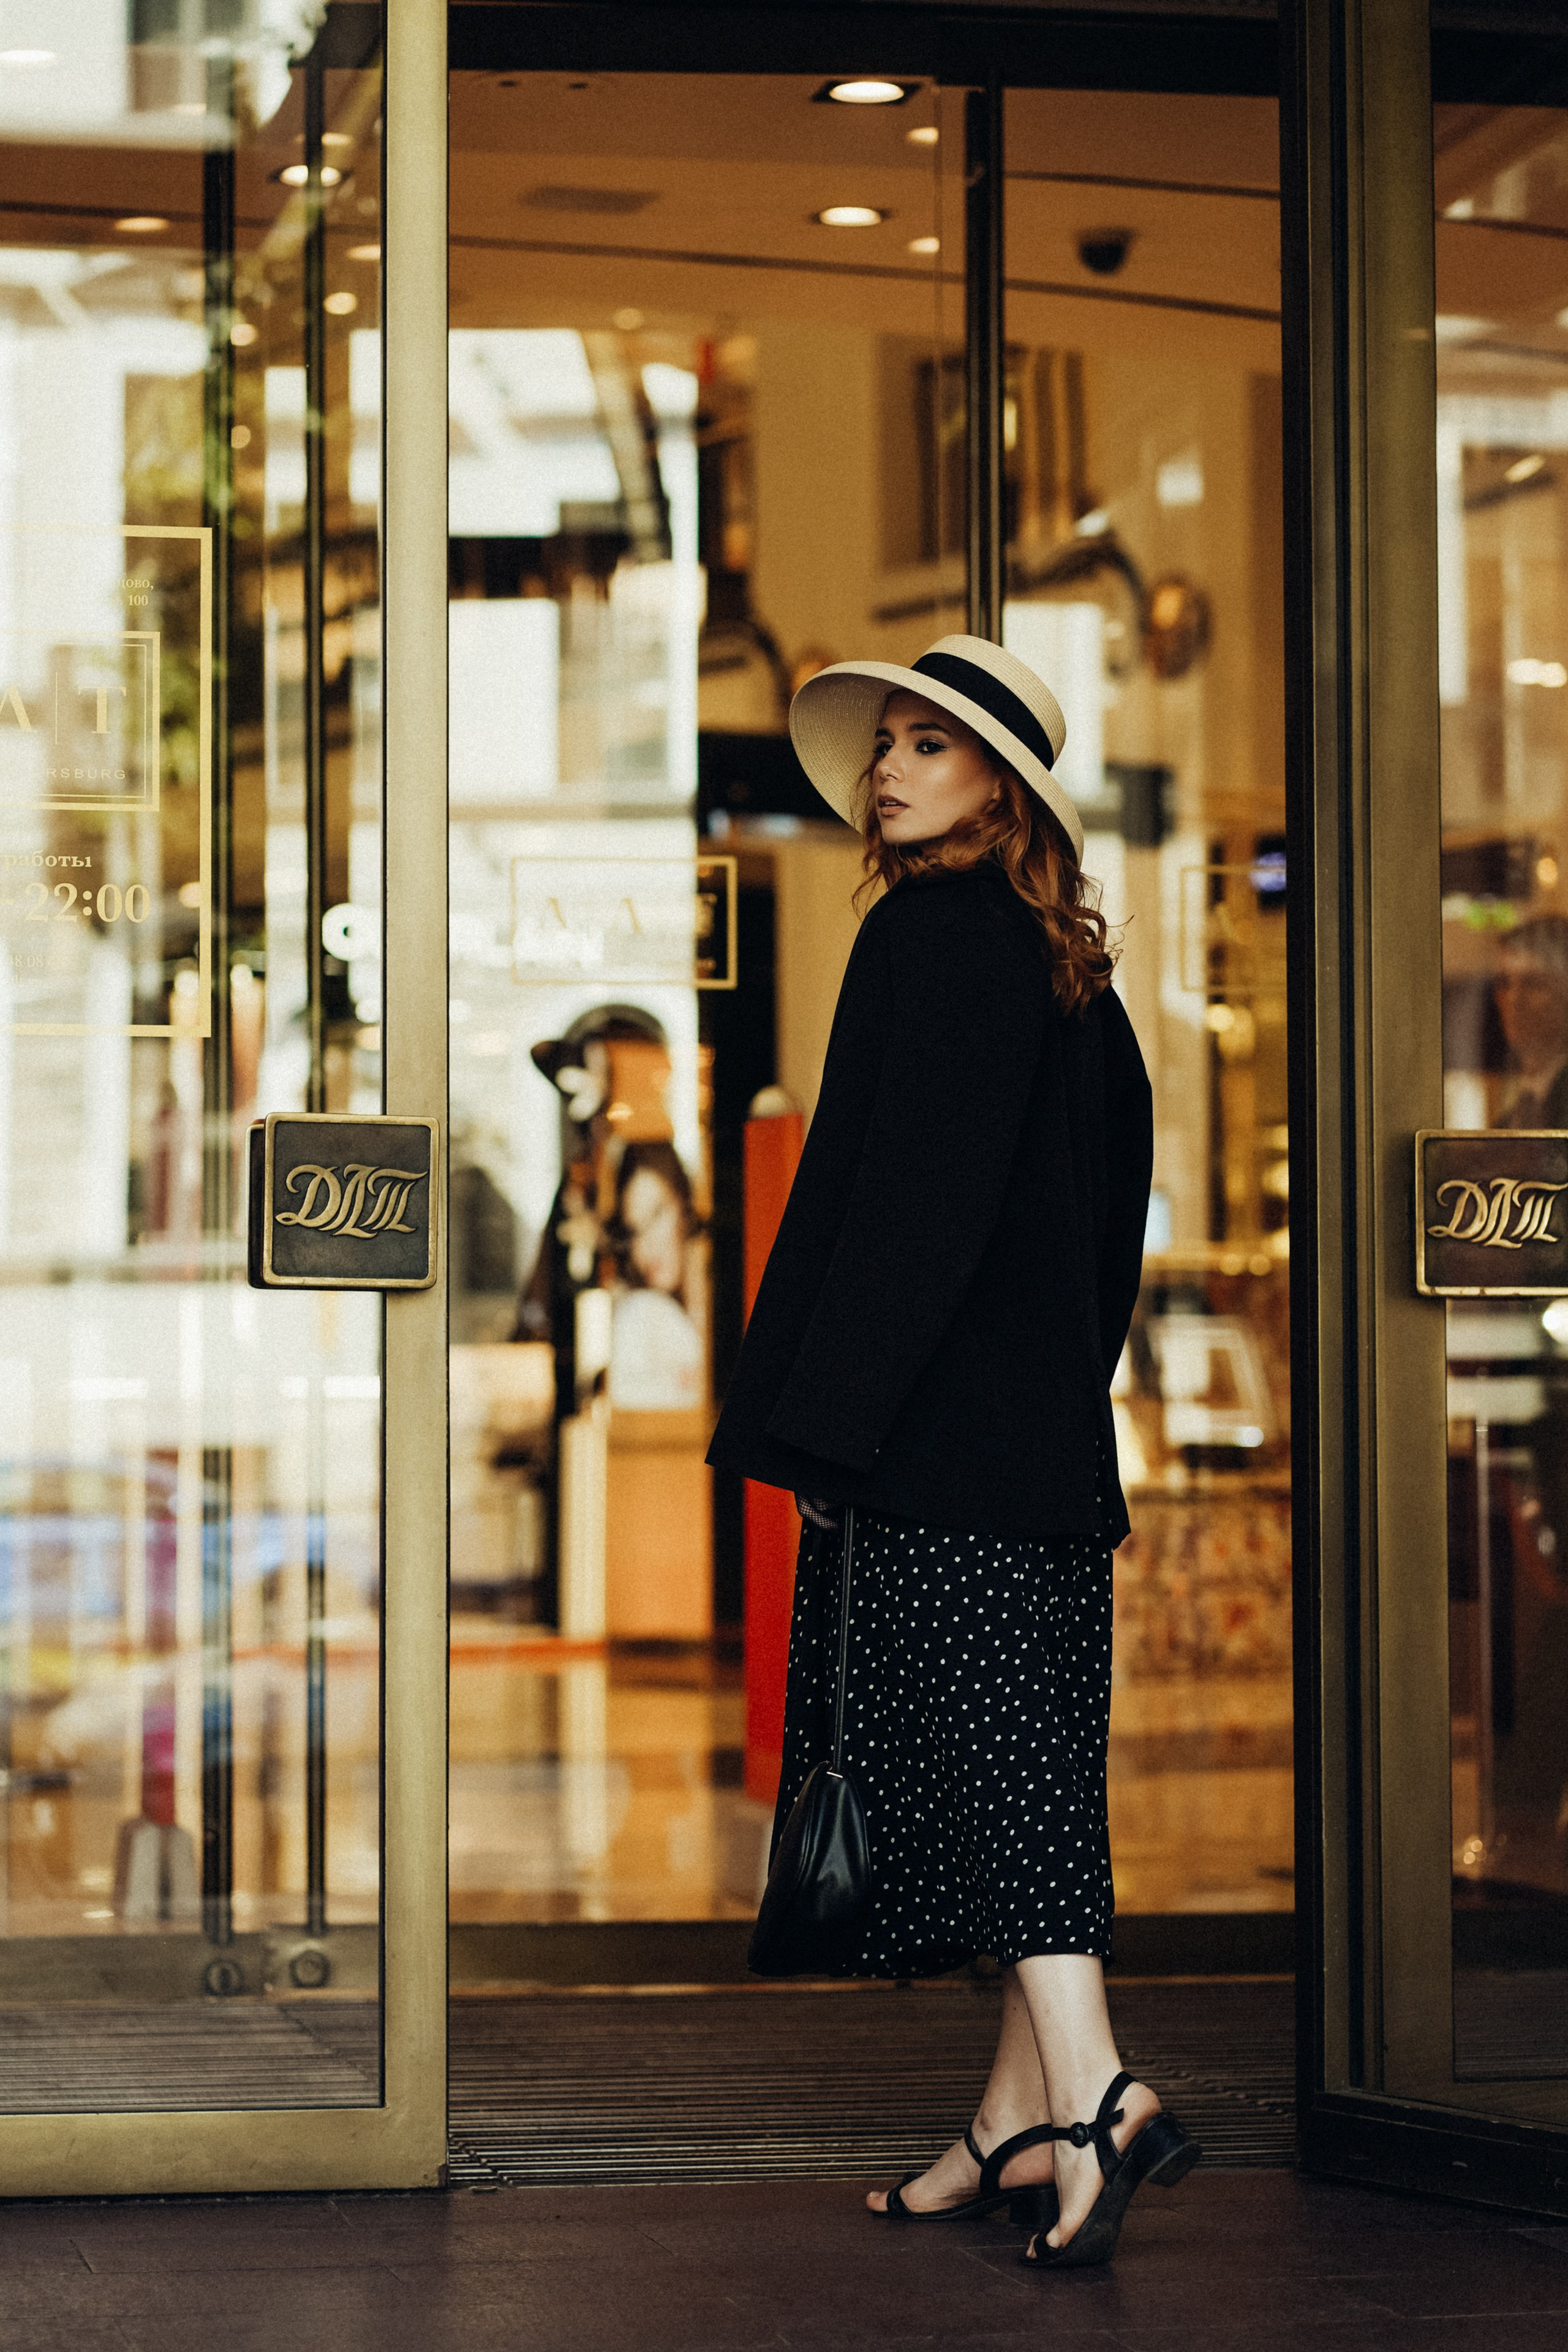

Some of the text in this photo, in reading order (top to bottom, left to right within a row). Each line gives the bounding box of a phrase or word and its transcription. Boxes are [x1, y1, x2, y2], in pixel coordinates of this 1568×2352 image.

[127, 594, 148, 606] 100
[47, 767, 126, 780] RSBURG
[4, 849, 92, 870] работы
[24, 882, 151, 923] 22:00
